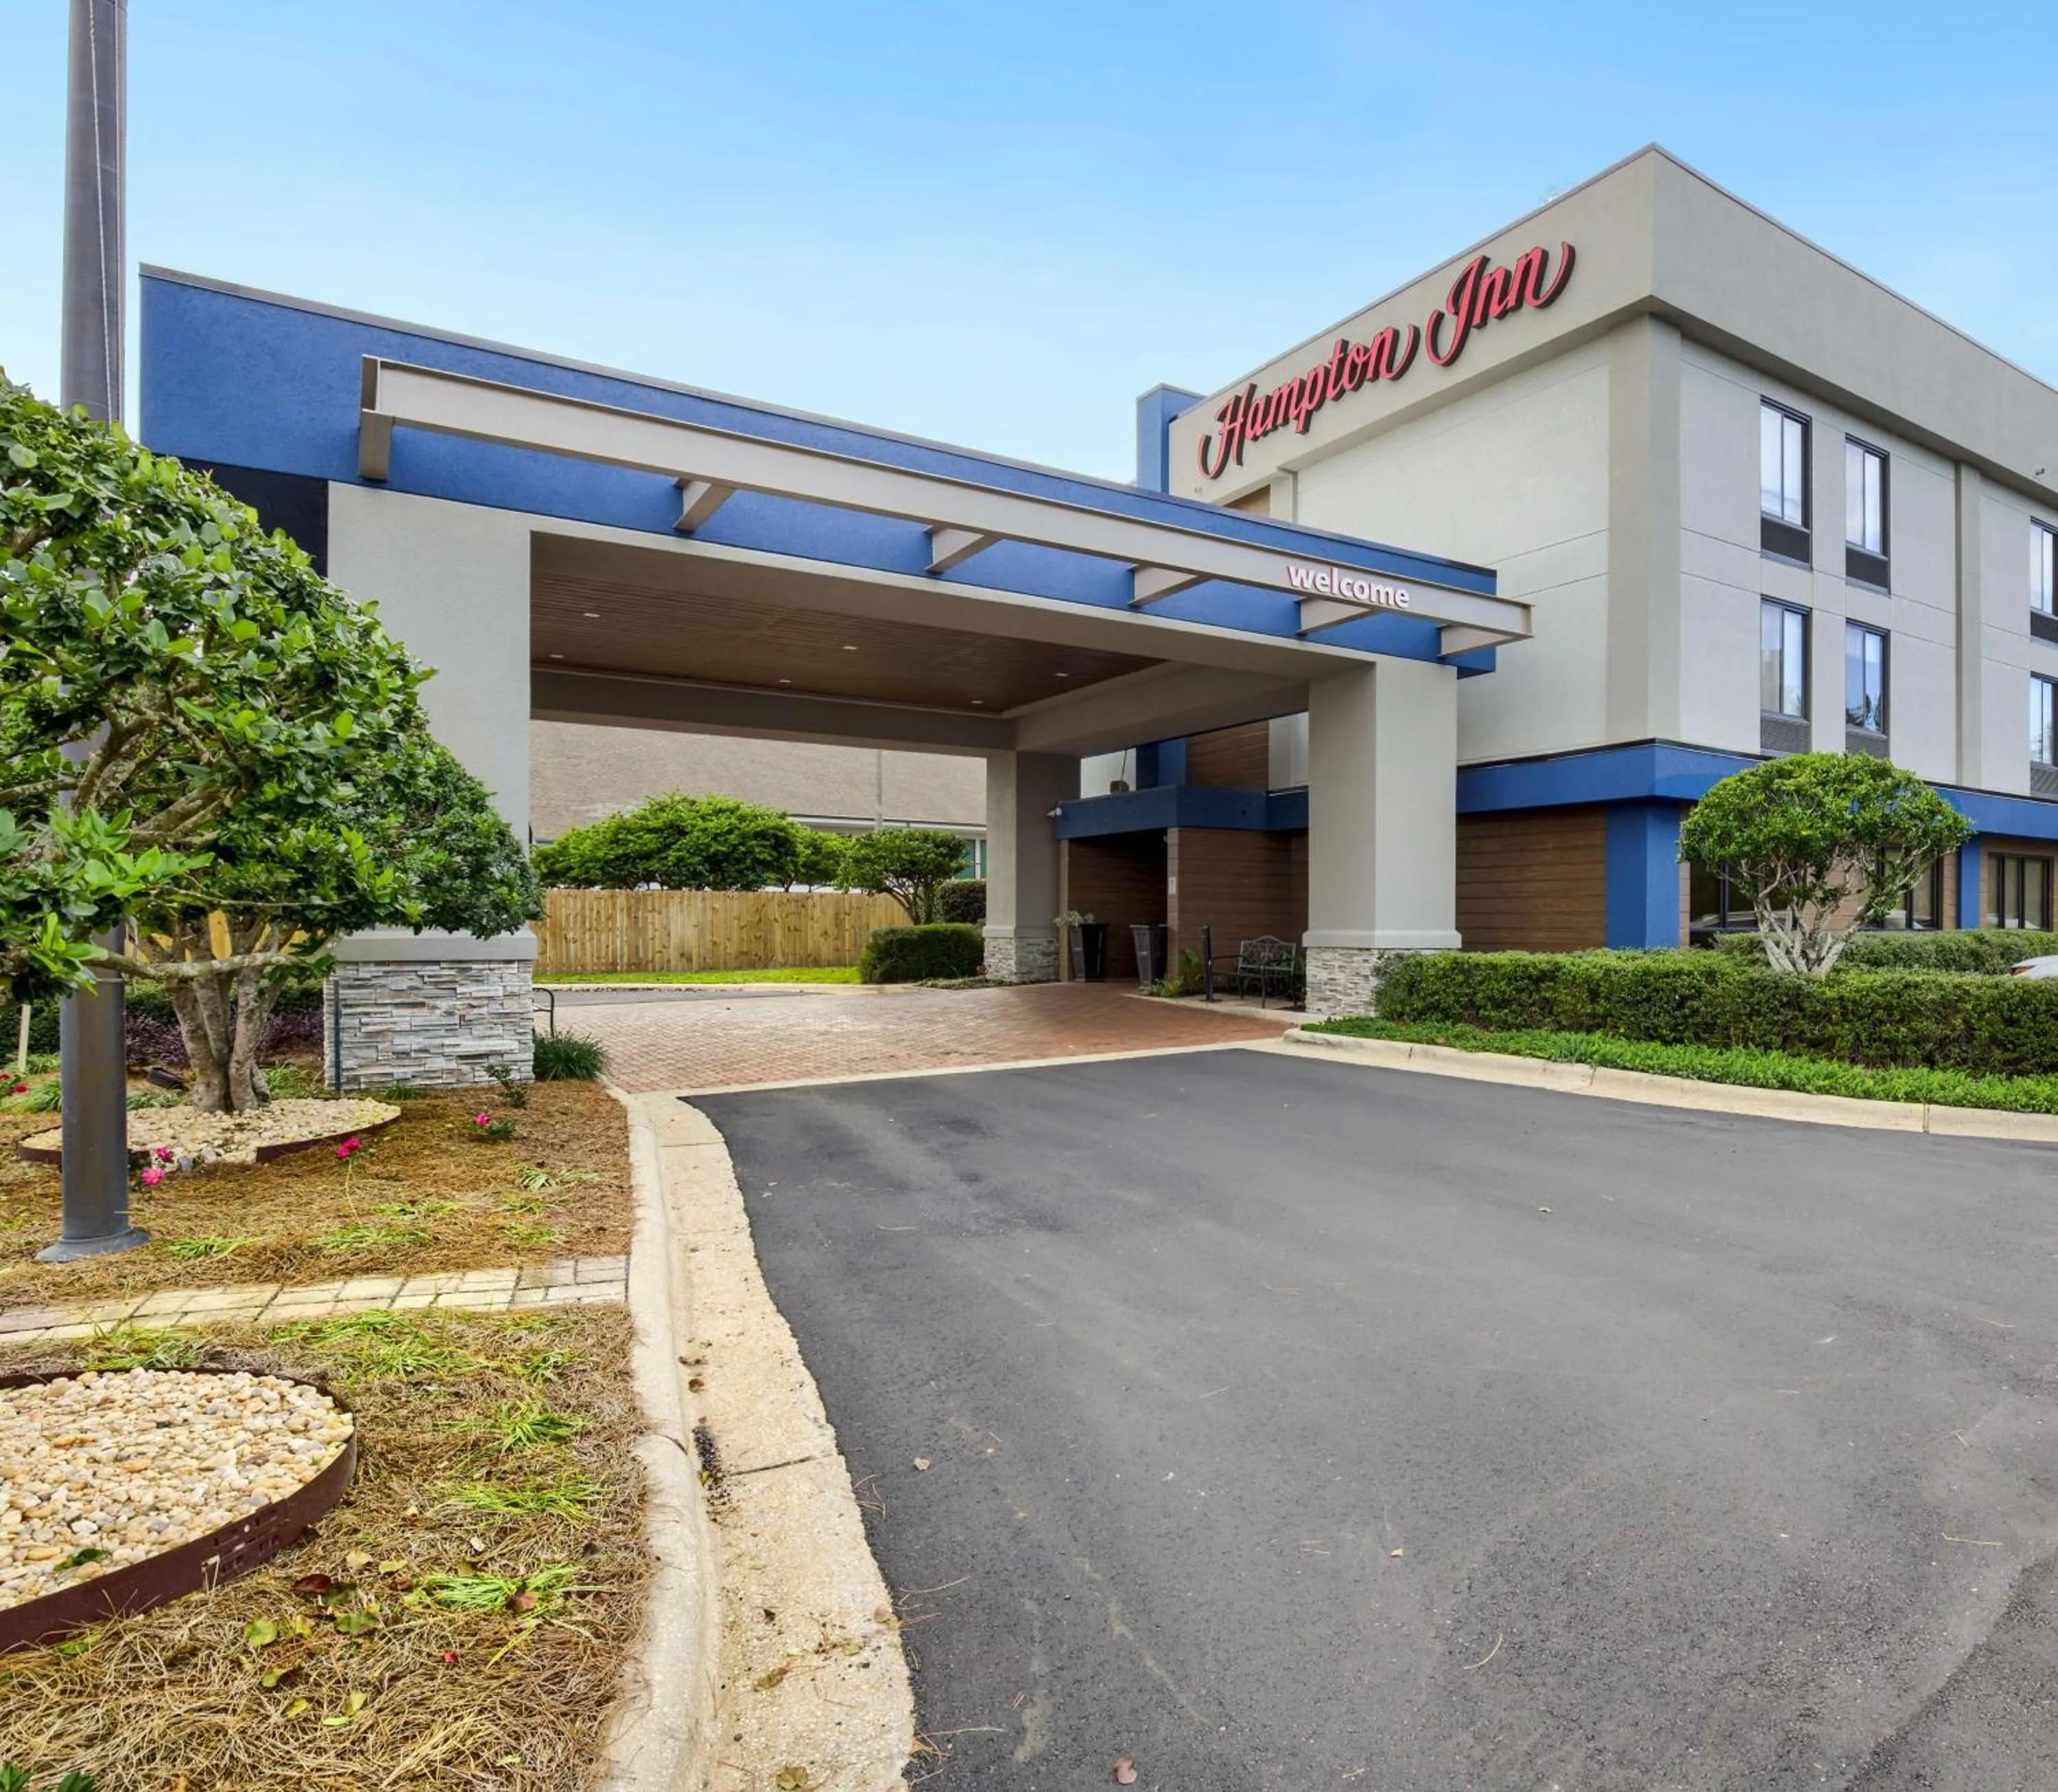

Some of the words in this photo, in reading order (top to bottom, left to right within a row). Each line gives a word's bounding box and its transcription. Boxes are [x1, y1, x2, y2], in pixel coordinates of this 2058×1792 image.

[1198, 323, 1420, 480] Hampton
[1426, 241, 1576, 367] Inn
[1287, 565, 1410, 608] welcome
